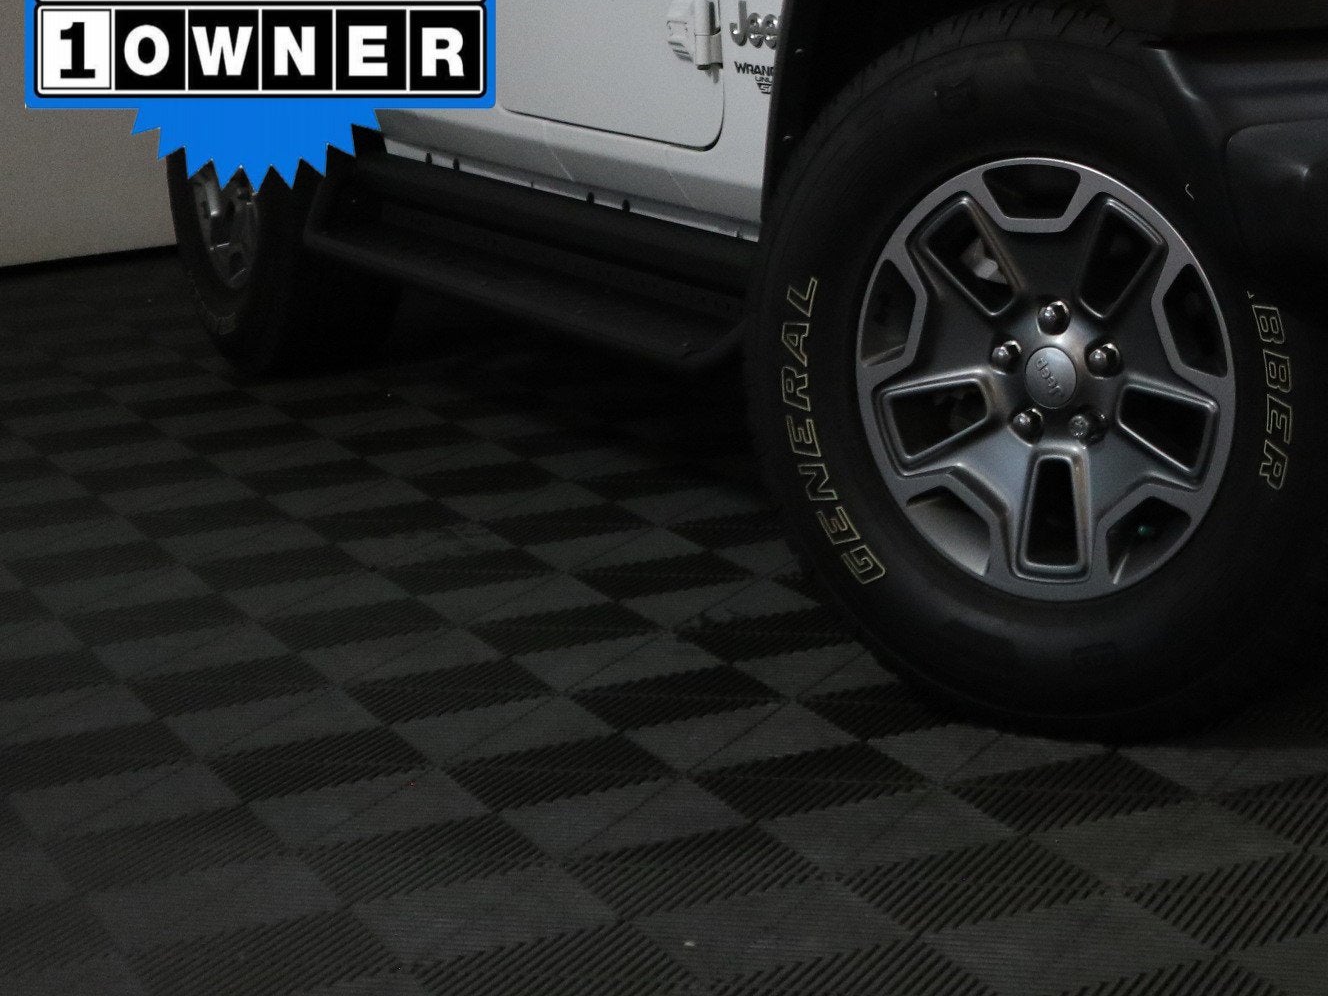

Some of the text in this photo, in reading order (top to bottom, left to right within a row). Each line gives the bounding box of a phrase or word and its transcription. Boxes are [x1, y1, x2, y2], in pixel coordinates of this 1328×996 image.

[729, 0, 780, 51] Jee
[734, 60, 774, 77] WRAN
[781, 276, 886, 585] GENERAL
[1251, 304, 1292, 490] BBER
